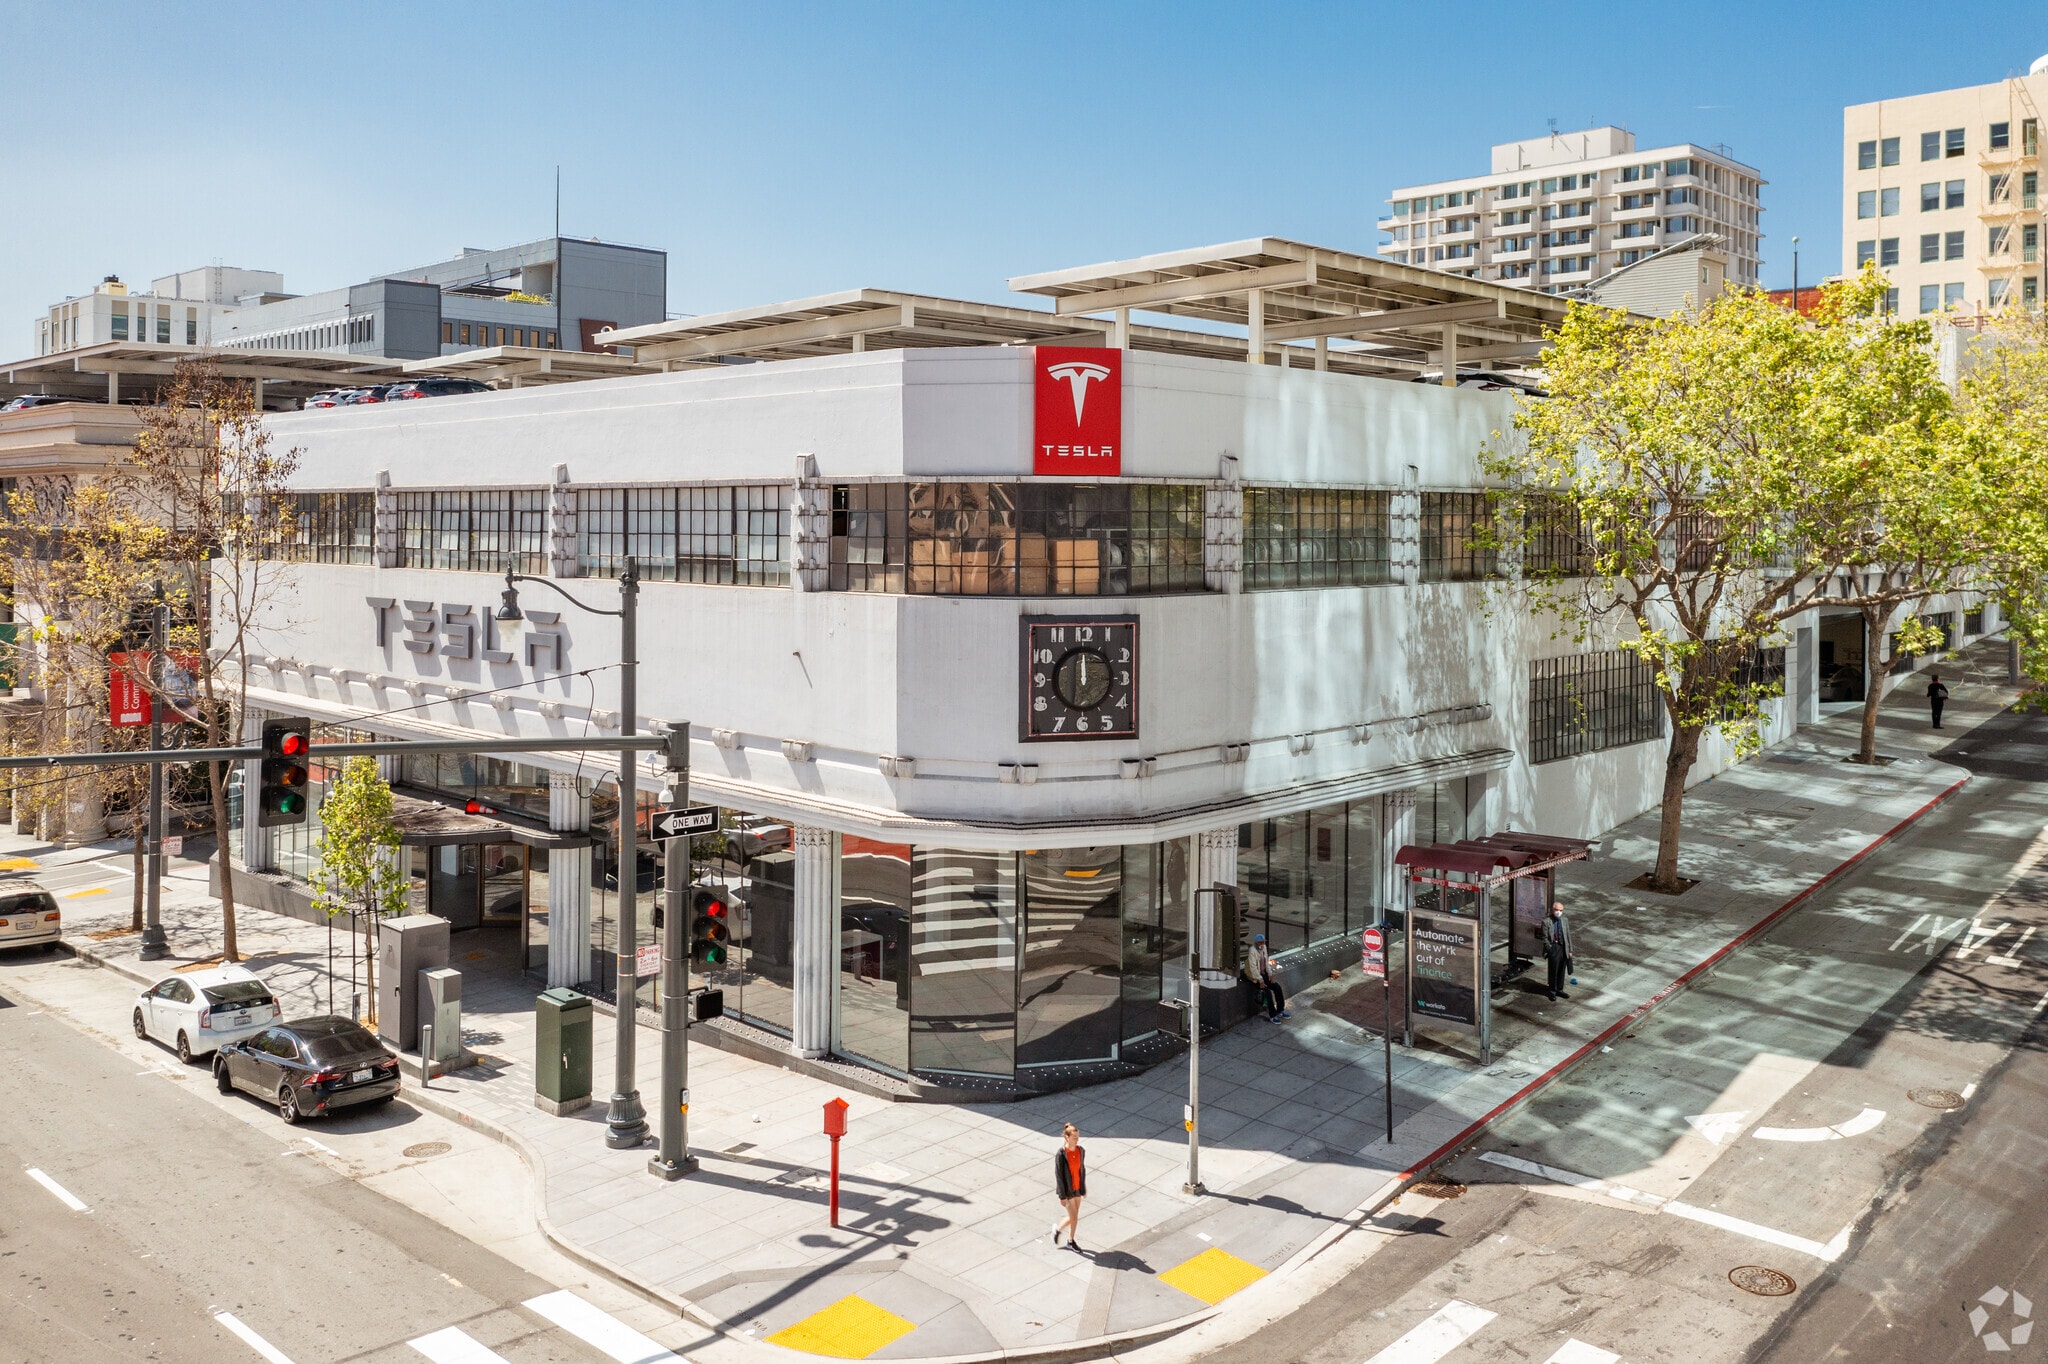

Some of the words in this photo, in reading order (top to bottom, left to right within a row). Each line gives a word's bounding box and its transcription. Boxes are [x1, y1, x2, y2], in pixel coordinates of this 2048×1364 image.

[1042, 445, 1112, 456] TESLA
[366, 597, 561, 670] TESLA
[1051, 627, 1064, 642] 11
[1075, 627, 1092, 641] 12
[1033, 649, 1052, 663] 10
[1118, 648, 1129, 662] 2
[1034, 673, 1045, 687] 9
[1120, 671, 1129, 685] 3
[1034, 696, 1047, 711] 8
[1115, 693, 1128, 708] 4
[1053, 717, 1065, 732] 7
[1076, 717, 1088, 731] 6
[1101, 716, 1113, 730] 5
[672, 818, 689, 828] ONE
[692, 815, 711, 825] WAY
[1416, 928, 1465, 945] Automate
[1888, 914, 2037, 968] TAXI
[1416, 941, 1431, 952] the
[1416, 954, 1433, 962] out
[1434, 957, 1445, 966] of
[1417, 964, 1453, 980] finance
[1425, 1002, 1446, 1011] workato
